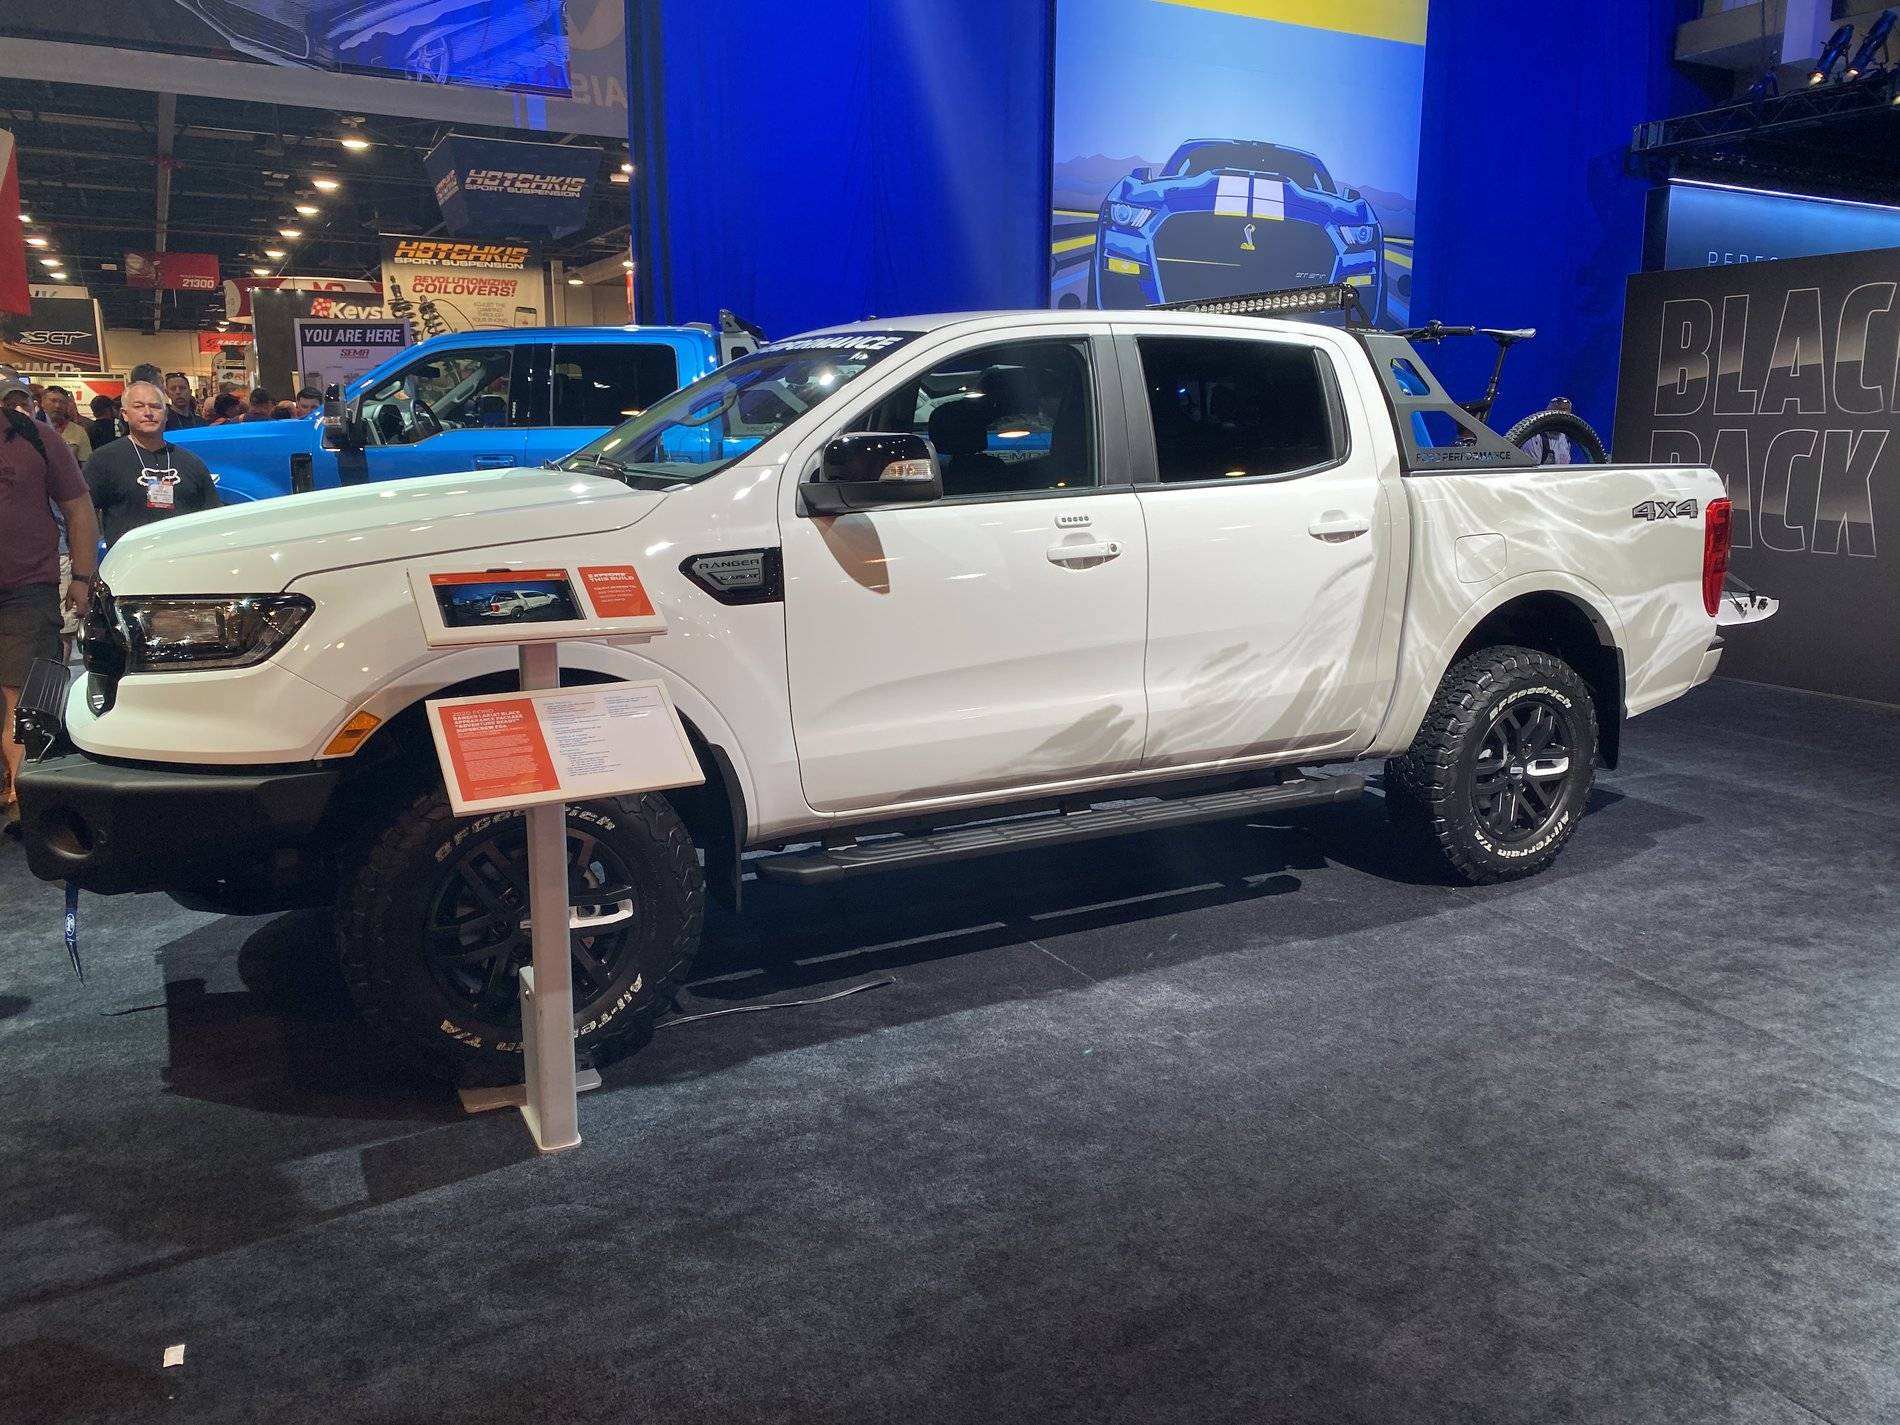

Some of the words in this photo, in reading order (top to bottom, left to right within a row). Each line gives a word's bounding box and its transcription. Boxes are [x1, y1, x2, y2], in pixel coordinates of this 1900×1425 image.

[464, 169, 586, 192] HOTCHKIS
[464, 183, 504, 192] SPORT
[507, 186, 581, 198] SUSPENSION
[394, 240, 529, 263] HOTCHKIS
[394, 257, 440, 266] SPORT
[442, 258, 524, 270] SUSPENSION
[182, 278, 214, 289] 21300
[413, 275, 518, 287] REVOLUTIONIZING
[412, 282, 516, 297] COILOVERS!
[330, 302, 383, 319] Keys
[304, 329, 333, 343] YOU
[336, 329, 362, 343] ARE
[366, 329, 401, 343] HERE
[1654, 281, 1900, 416] BLAC
[1650, 428, 1890, 558] ACK
[699, 558, 760, 570] RANGER
[1489, 686, 1572, 722] BFGoodrich
